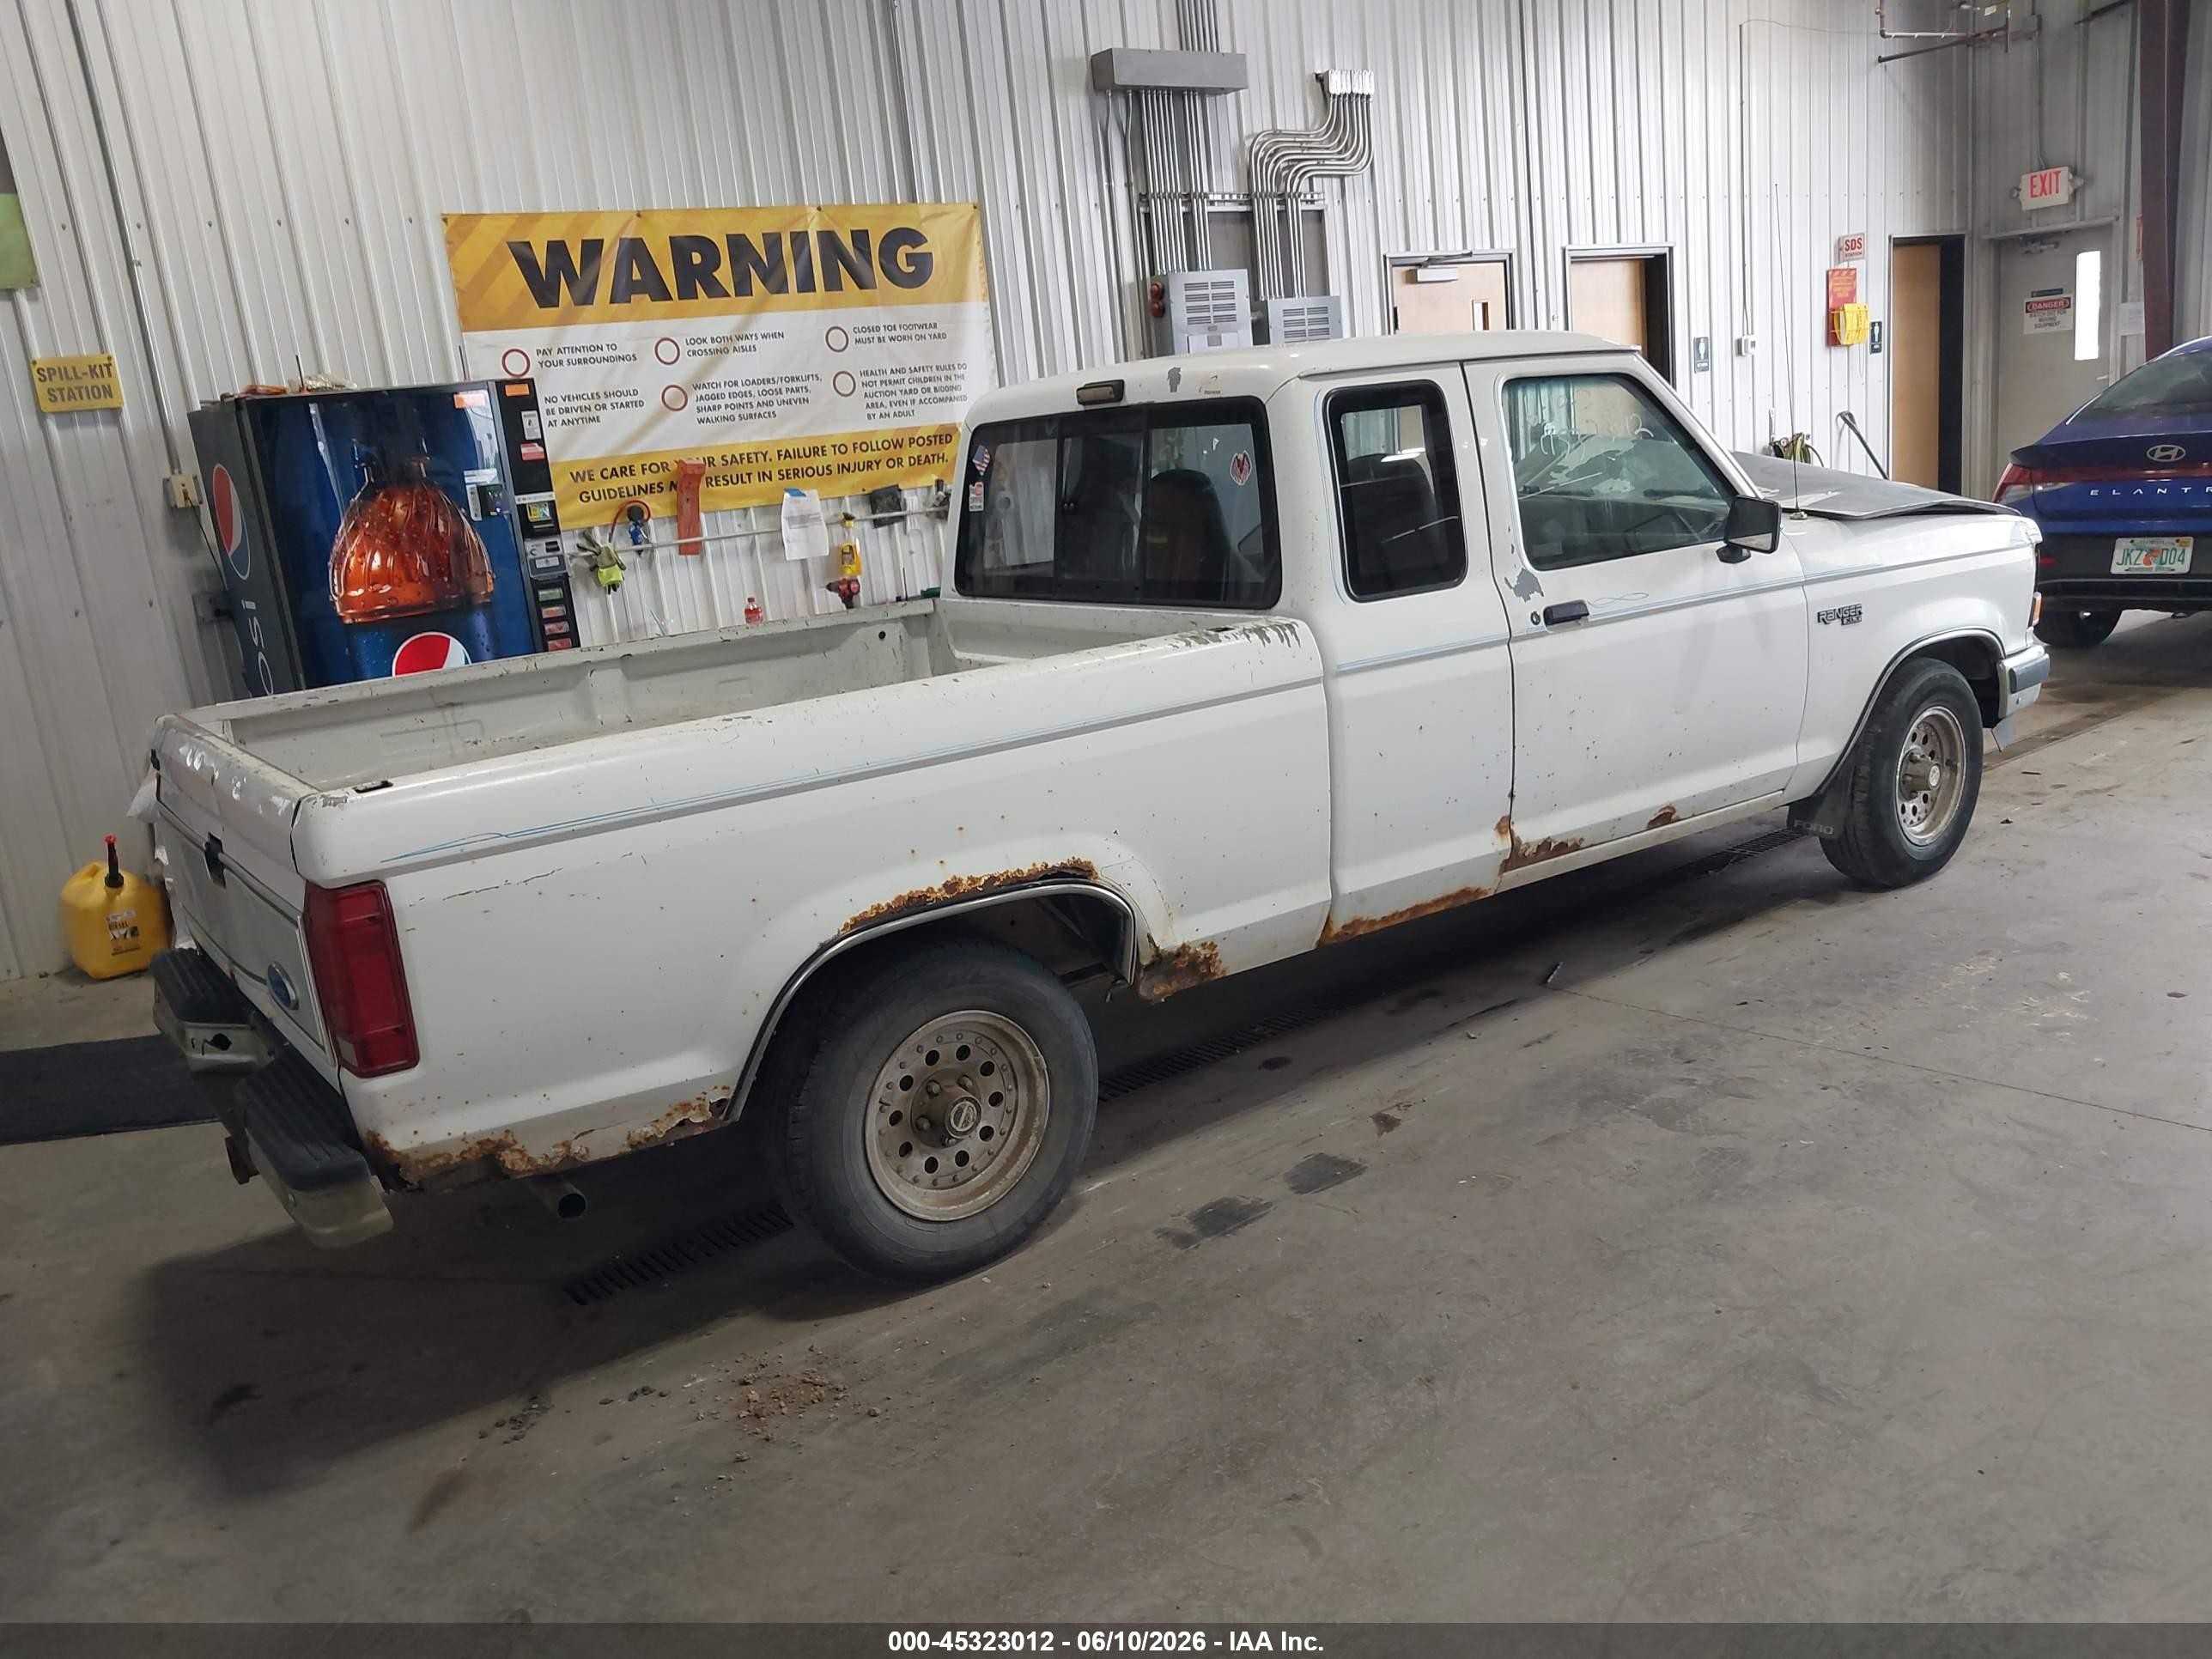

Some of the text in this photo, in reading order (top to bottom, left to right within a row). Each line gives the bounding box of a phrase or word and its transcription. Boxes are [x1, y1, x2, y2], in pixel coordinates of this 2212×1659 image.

[2031, 170, 2062, 198] EXIT
[1844, 238, 1863, 251] SDS
[507, 228, 933, 308] WARNING
[898, 322, 936, 331] FOOTWEAR
[685, 337, 708, 345] LOOK
[710, 335, 732, 343] BOTH
[735, 332, 757, 341] WAYS
[536, 347, 552, 356] PAY
[556, 343, 603, 354] ATTENTION
[687, 346, 729, 356] CROSSING
[538, 353, 637, 368] YOUR SURROUNDINGS
[36, 363, 112, 382] SPILL-KIT
[908, 374, 941, 384] CHILDREN
[692, 381, 720, 390] WATCH
[742, 374, 822, 386] LOADERS/FORKLIFTS,
[47, 385, 113, 403] STATION
[560, 392, 600, 402] VEHICLES
[604, 388, 638, 398] SHOULD
[696, 386, 811, 401] JAGGED EDGES, LOOSE PARTS,
[864, 389, 896, 398] AUCTION
[934, 384, 961, 392] BIDDING
[696, 403, 721, 413] SHARP
[725, 401, 753, 410] POINTS
[776, 397, 809, 406] UNEVEN
[919, 394, 967, 404] ACCOMPANIED
[558, 404, 591, 414] DRIVEN
[610, 399, 644, 410] STARTED
[893, 409, 914, 417] ADULT
[561, 416, 600, 426] ANYTIME
[696, 410, 776, 424] WALKING SURFACES
[569, 469, 594, 483] WE
[599, 465, 635, 479] CARE
[641, 461, 670, 475] FOR
[721, 451, 772, 466] SAFETY.
[777, 445, 827, 460] FAILURE
[831, 443, 848, 454] TO
[853, 437, 903, 453] FOLLOW
[908, 433, 952, 447] POSTED
[579, 481, 664, 502] GUIDELINES
[705, 470, 752, 488] RESULT
[757, 468, 772, 483] IN
[777, 464, 832, 480] SERIOUS
[837, 459, 880, 474] INJURY
[886, 456, 903, 468] OR
[908, 452, 948, 465] DEATH.
